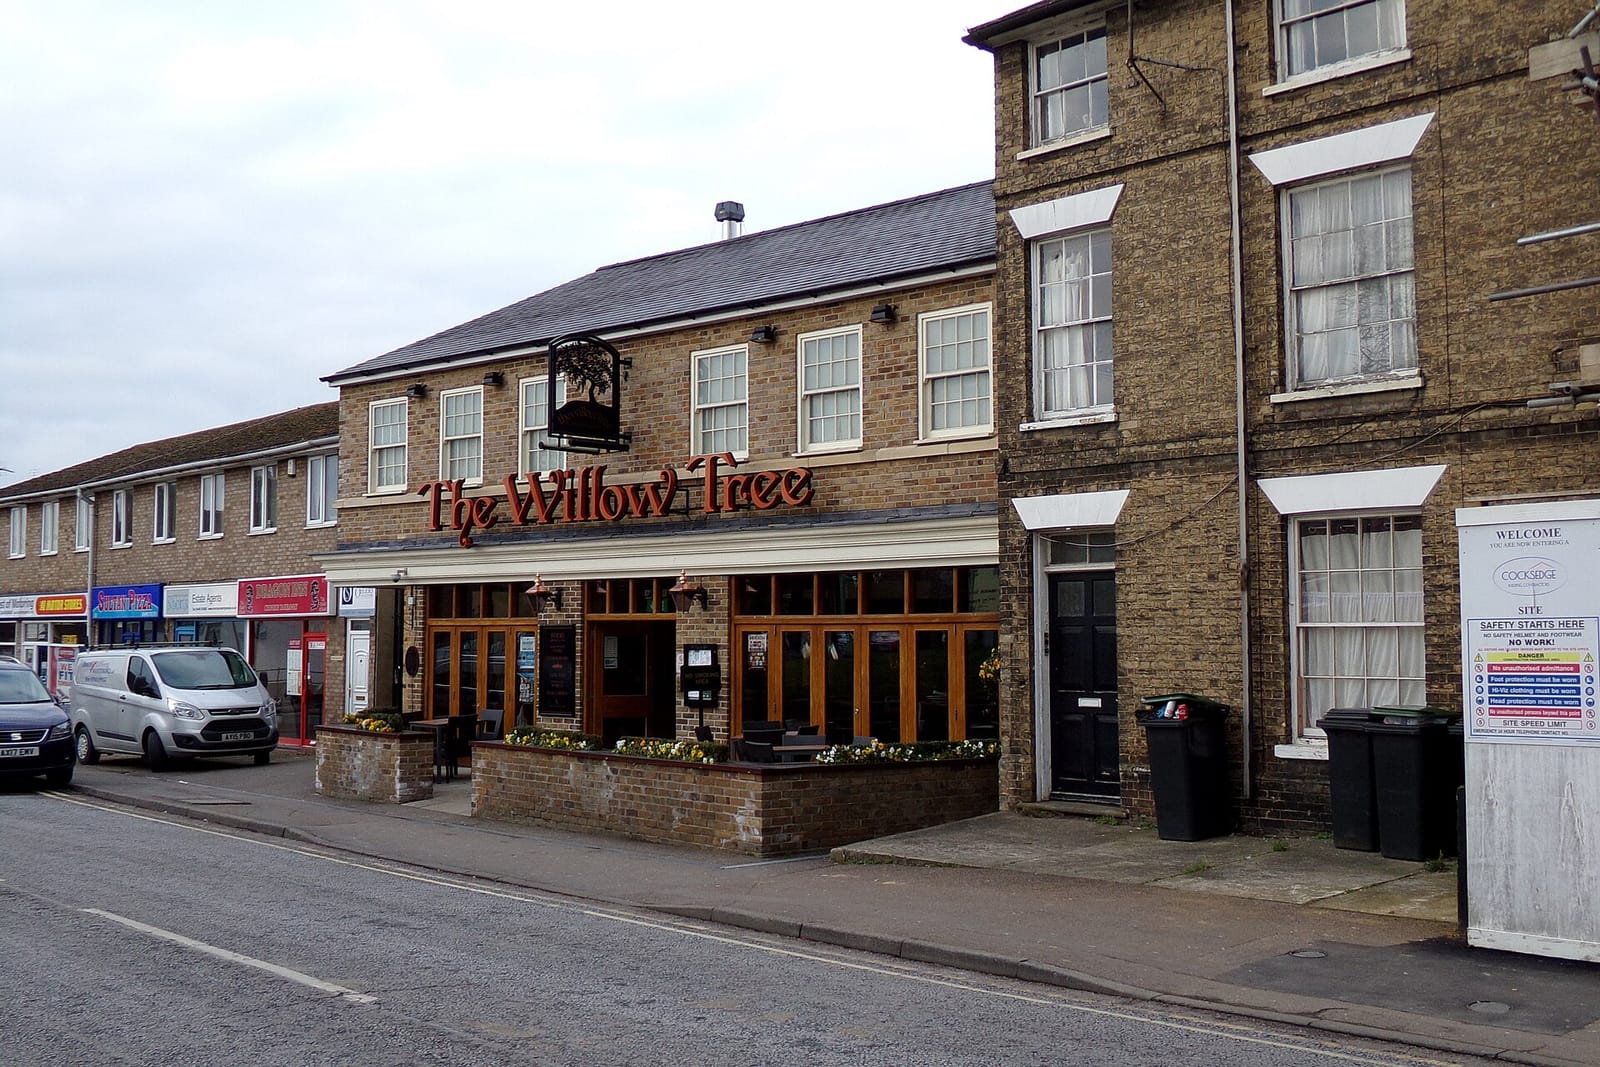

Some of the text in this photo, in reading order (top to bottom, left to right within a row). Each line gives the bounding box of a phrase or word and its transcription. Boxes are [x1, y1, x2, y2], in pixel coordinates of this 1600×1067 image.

[417, 451, 814, 548] The Willow Tree
[1496, 528, 1562, 540] WELCOME
[1501, 570, 1556, 580] COCKSEDGE
[256, 582, 290, 598] DRAGON
[291, 581, 308, 597] INN
[128, 590, 152, 611] PIZZA
[192, 593, 222, 604] Estate Agents
[1518, 606, 1543, 614] SITE
[1480, 620, 1584, 630] SAFETY STARTS HERE
[58, 671, 73, 680] FIT
